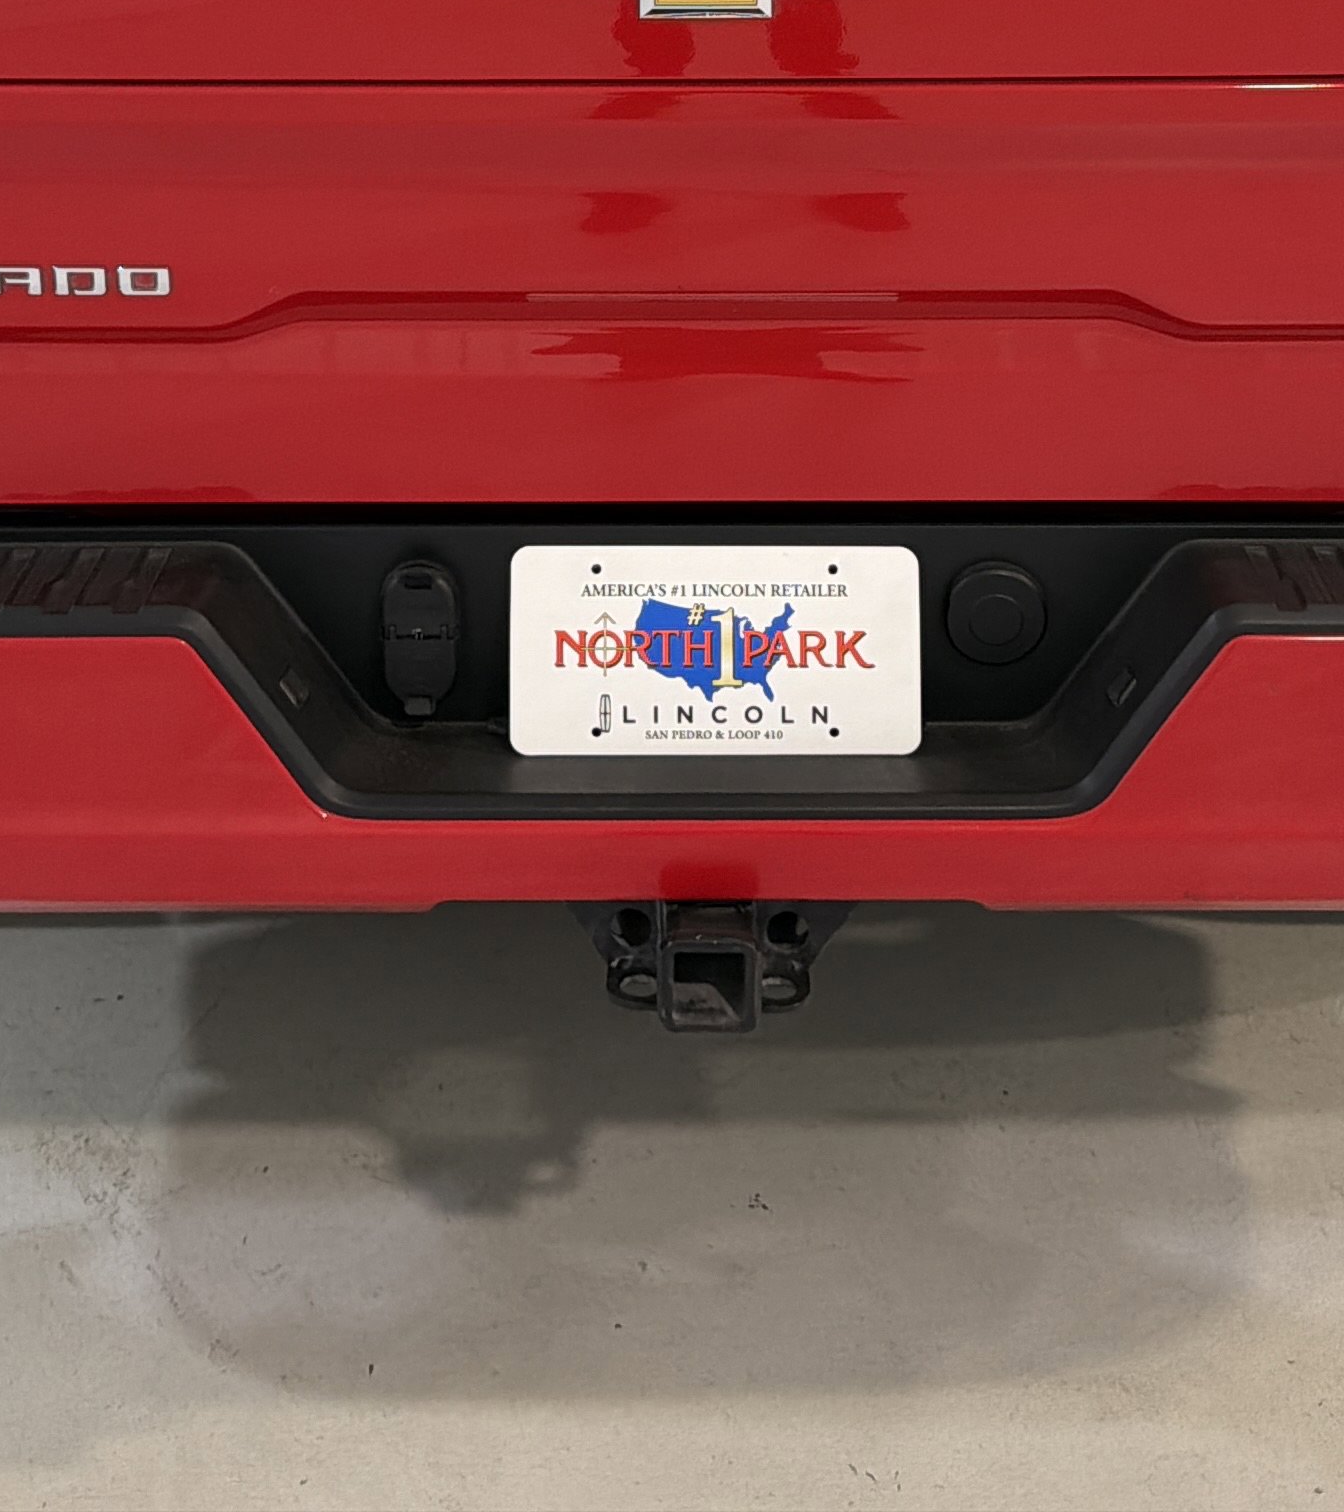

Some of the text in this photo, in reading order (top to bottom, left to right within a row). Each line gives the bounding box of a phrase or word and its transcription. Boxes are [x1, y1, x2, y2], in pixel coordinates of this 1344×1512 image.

[581, 583, 848, 597] AMERICA'S #1 LINCOLN RETAILER
[553, 629, 876, 669] NORTH PARK
[622, 705, 829, 724] LINCOLN
[645, 730, 784, 740] SAN PEDRO & LOOP 410
